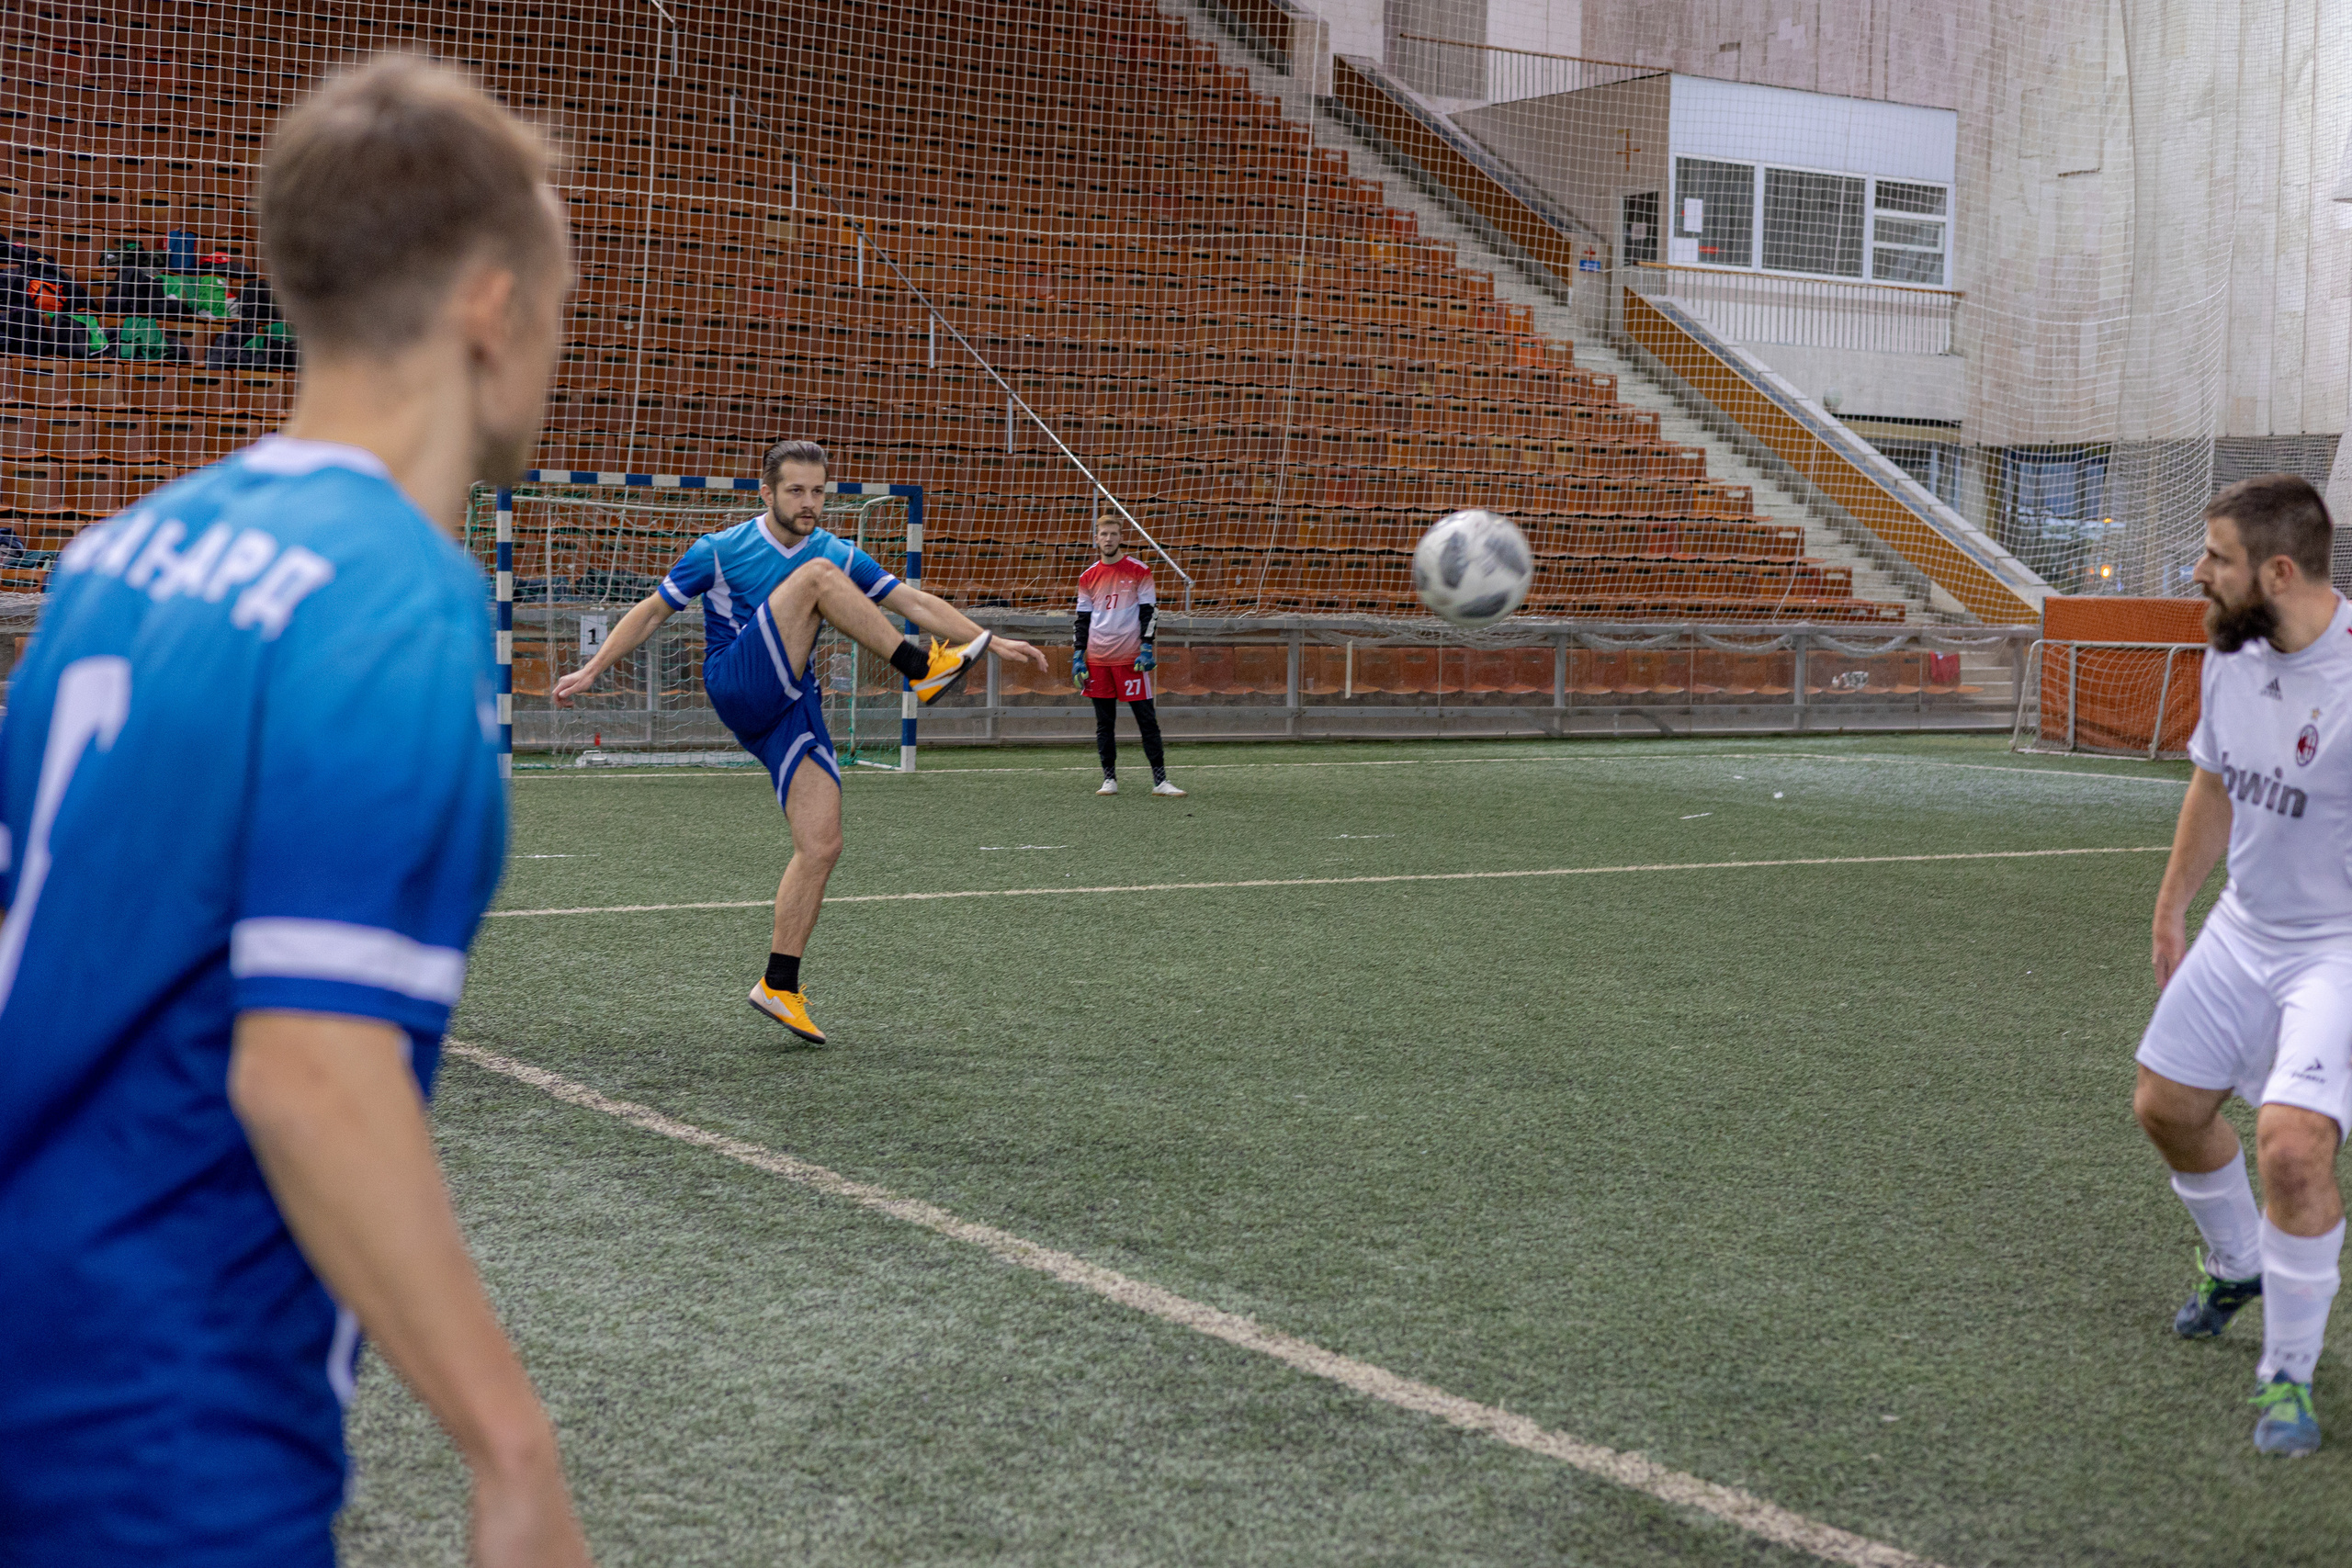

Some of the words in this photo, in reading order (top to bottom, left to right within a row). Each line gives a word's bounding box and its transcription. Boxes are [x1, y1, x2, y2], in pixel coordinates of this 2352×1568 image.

[1105, 593, 1119, 610] 27
[588, 627, 599, 645] 1
[1125, 678, 1142, 696] 27
